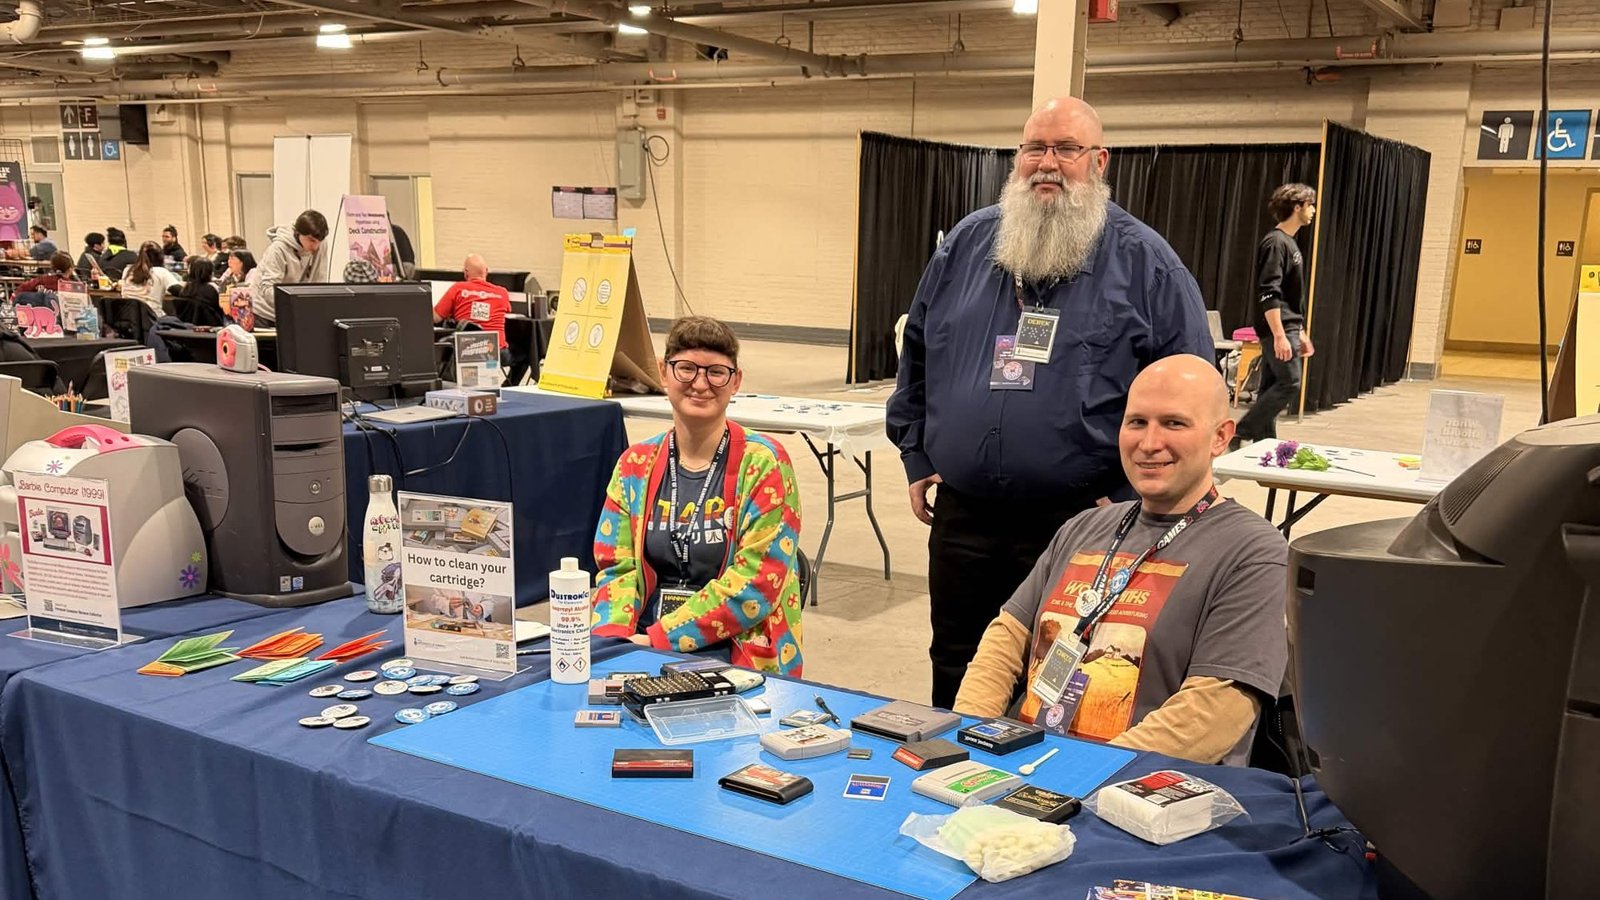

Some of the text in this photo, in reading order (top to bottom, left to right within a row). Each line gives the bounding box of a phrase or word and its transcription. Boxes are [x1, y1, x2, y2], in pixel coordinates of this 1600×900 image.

[717, 436, 727, 454] LIBRARY
[18, 479, 105, 500] Barbie Computer (1999)
[1157, 518, 1187, 550] GAMES
[407, 553, 507, 575] How to clean your
[429, 573, 485, 590] cartridge?
